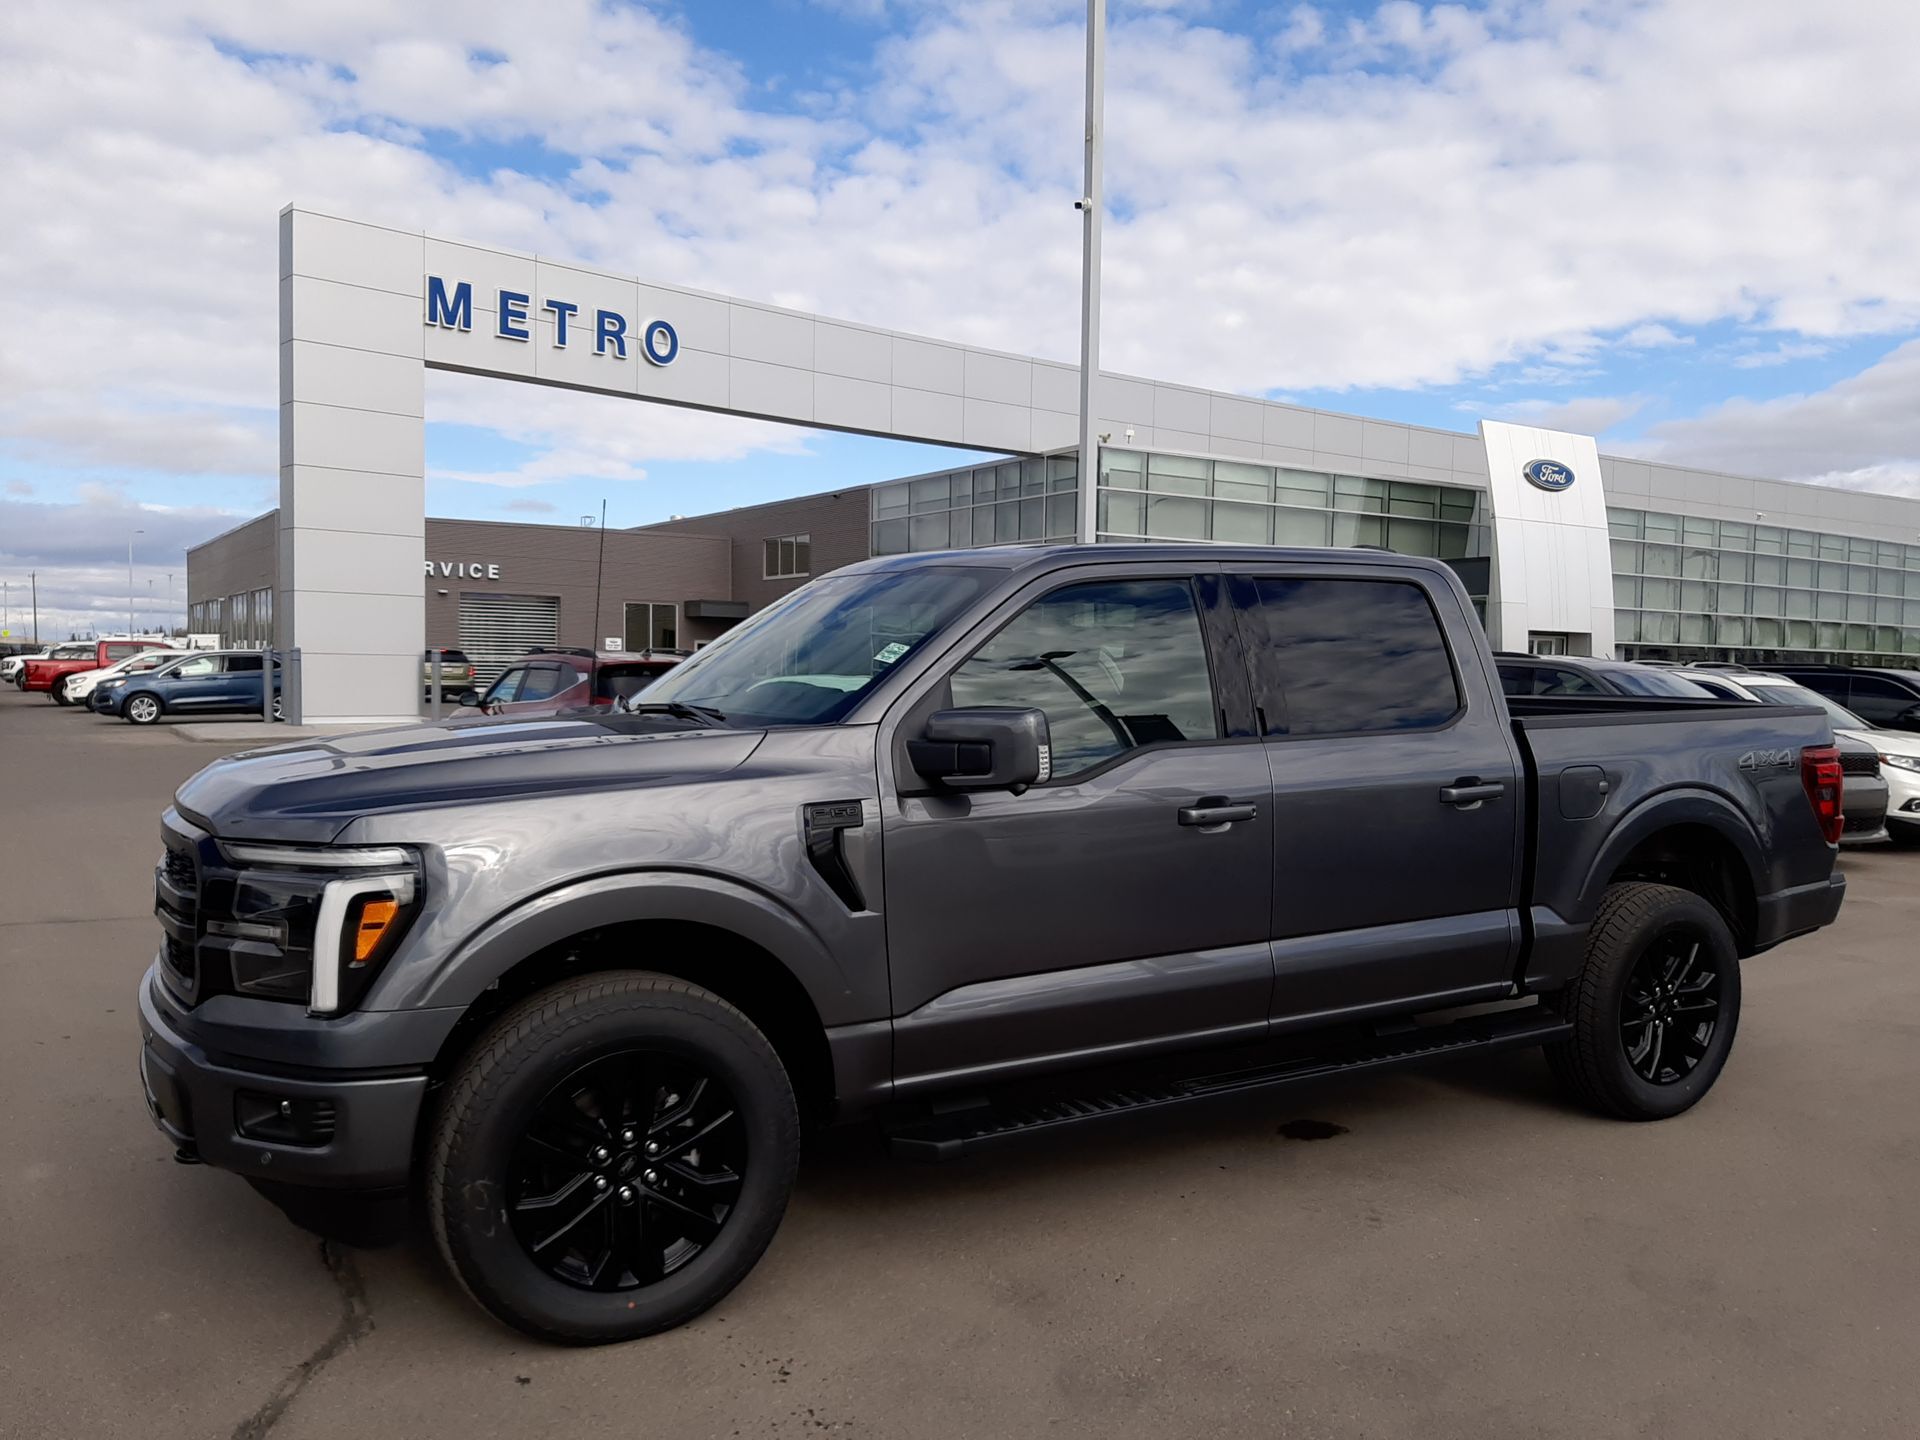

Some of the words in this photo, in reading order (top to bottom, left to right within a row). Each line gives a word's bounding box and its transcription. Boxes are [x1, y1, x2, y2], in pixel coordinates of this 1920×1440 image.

[425, 273, 680, 367] METRO
[1539, 464, 1566, 484] Ford
[811, 805, 859, 819] F-150
